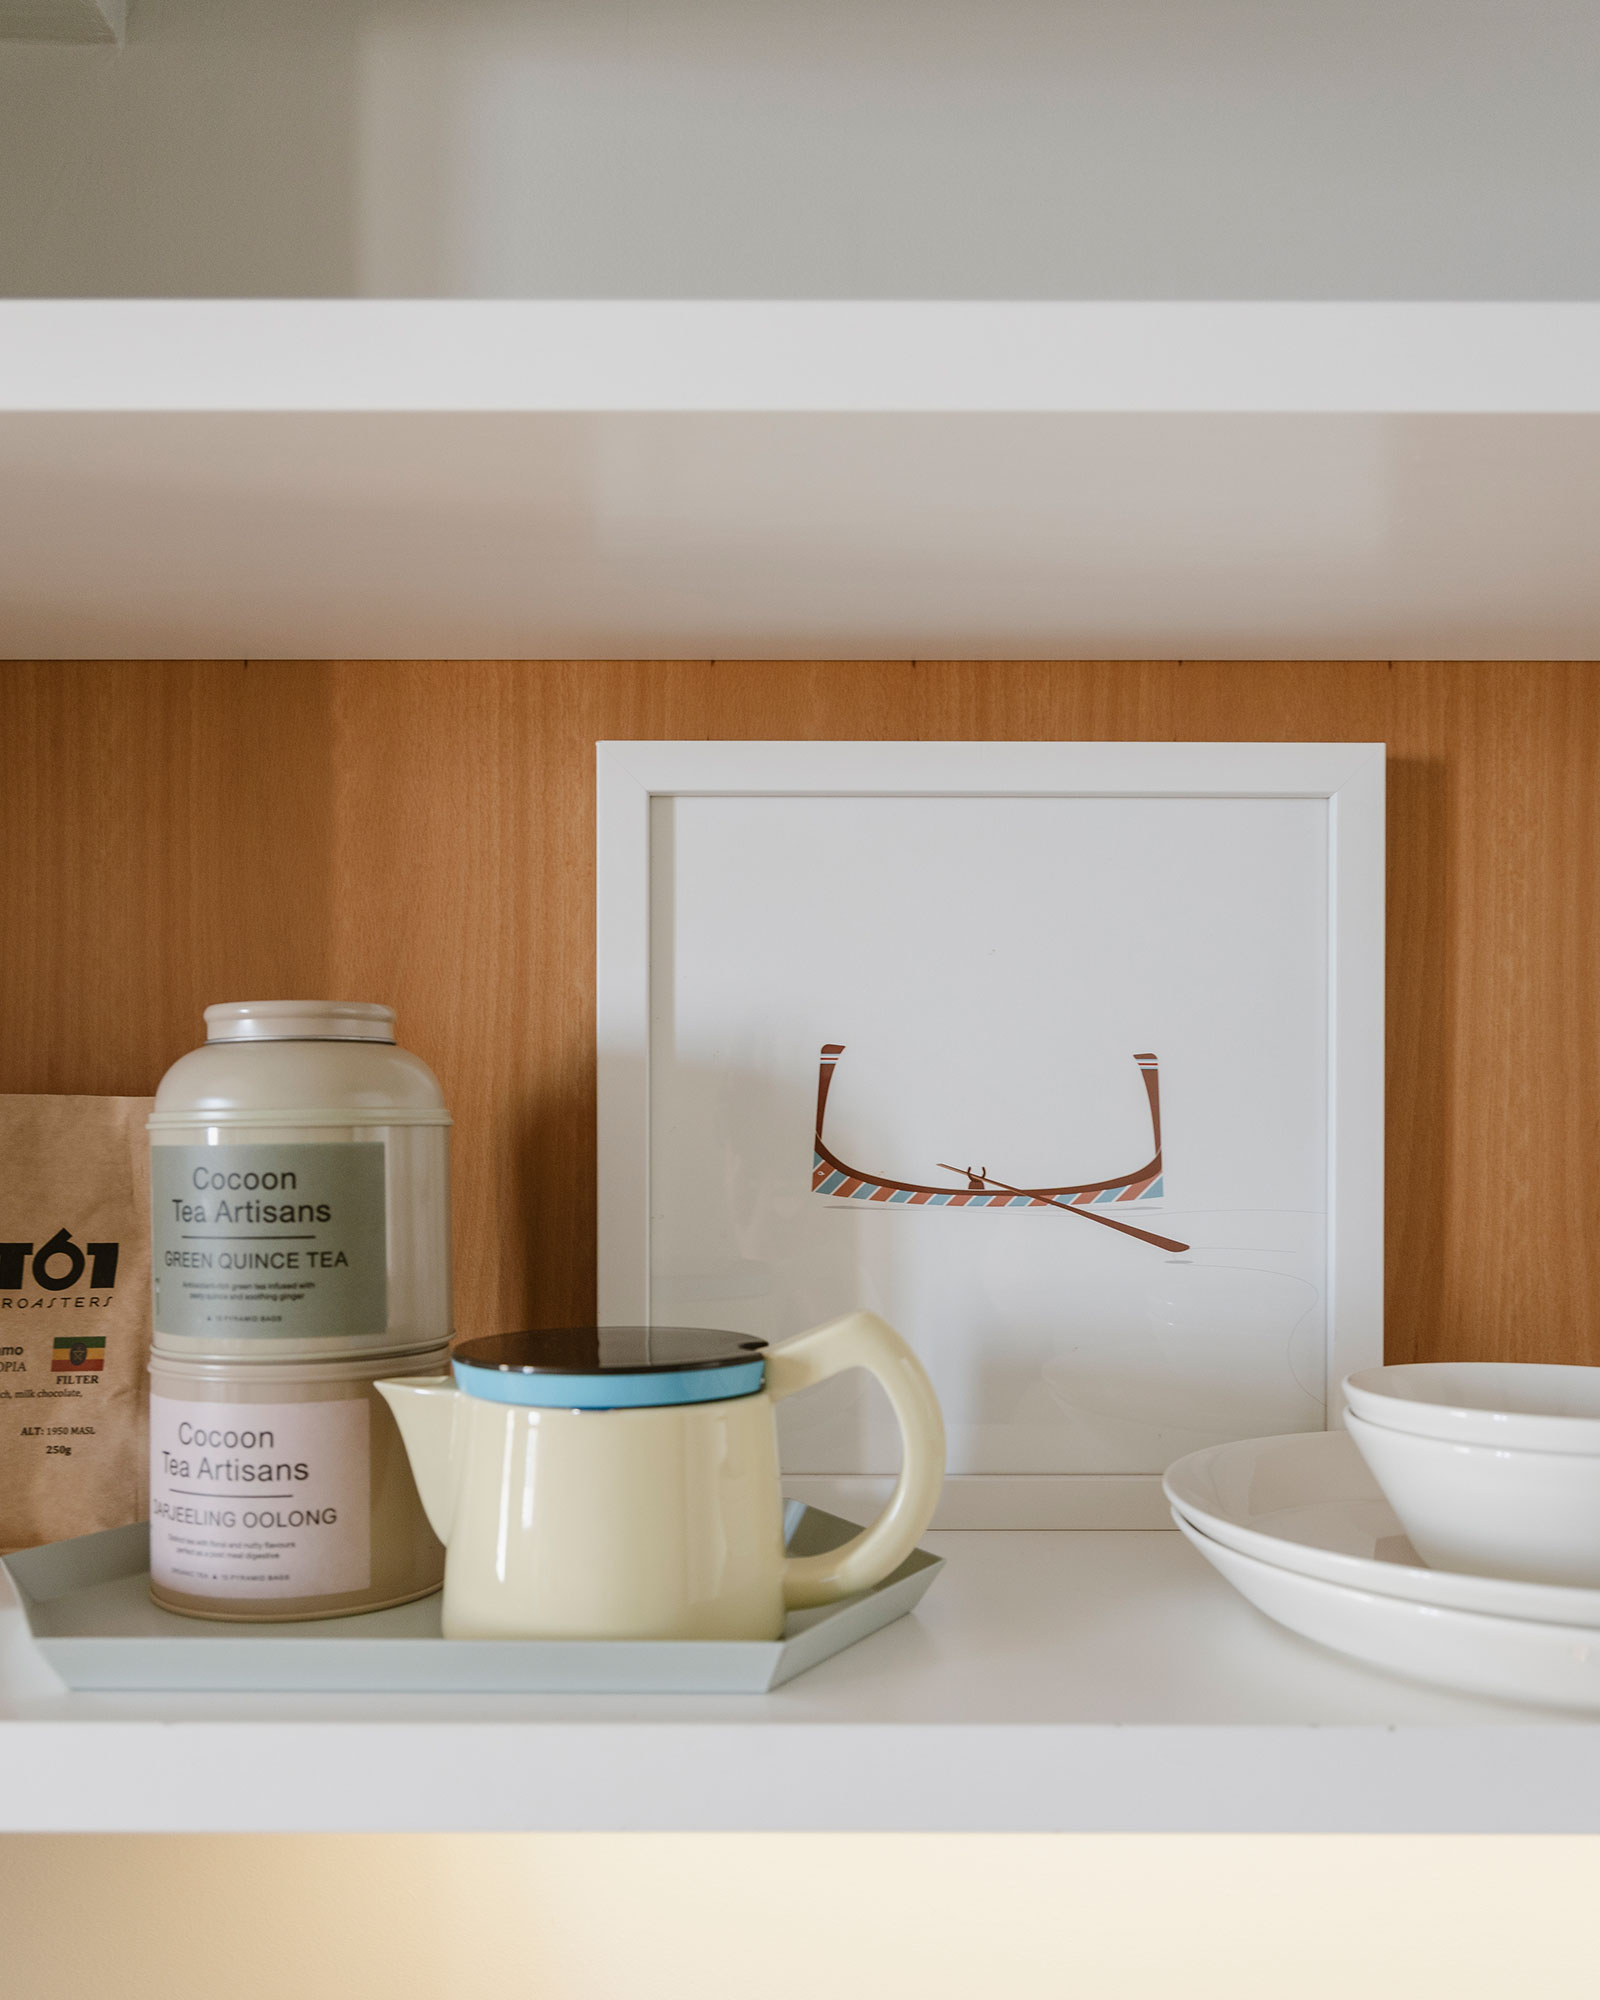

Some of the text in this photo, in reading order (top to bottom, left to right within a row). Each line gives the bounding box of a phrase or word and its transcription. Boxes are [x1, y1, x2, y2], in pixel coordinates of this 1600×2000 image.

[193, 1166, 297, 1191] Cocoon
[172, 1199, 332, 1224] Tea Artisans
[164, 1250, 349, 1270] GREEN QUINCE TEA
[1, 1296, 113, 1309] ROASTERS
[0, 1346, 24, 1356] mo
[56, 1375, 99, 1385] FILTER
[37, 1388, 83, 1398] chocolate,
[20, 1426, 96, 1436] ALT: 1950 MASL
[178, 1422, 274, 1449] Cocoon
[46, 1445, 72, 1456] 250g
[162, 1451, 309, 1482] Tea Artisans
[242, 1508, 338, 1528] OOLONG
